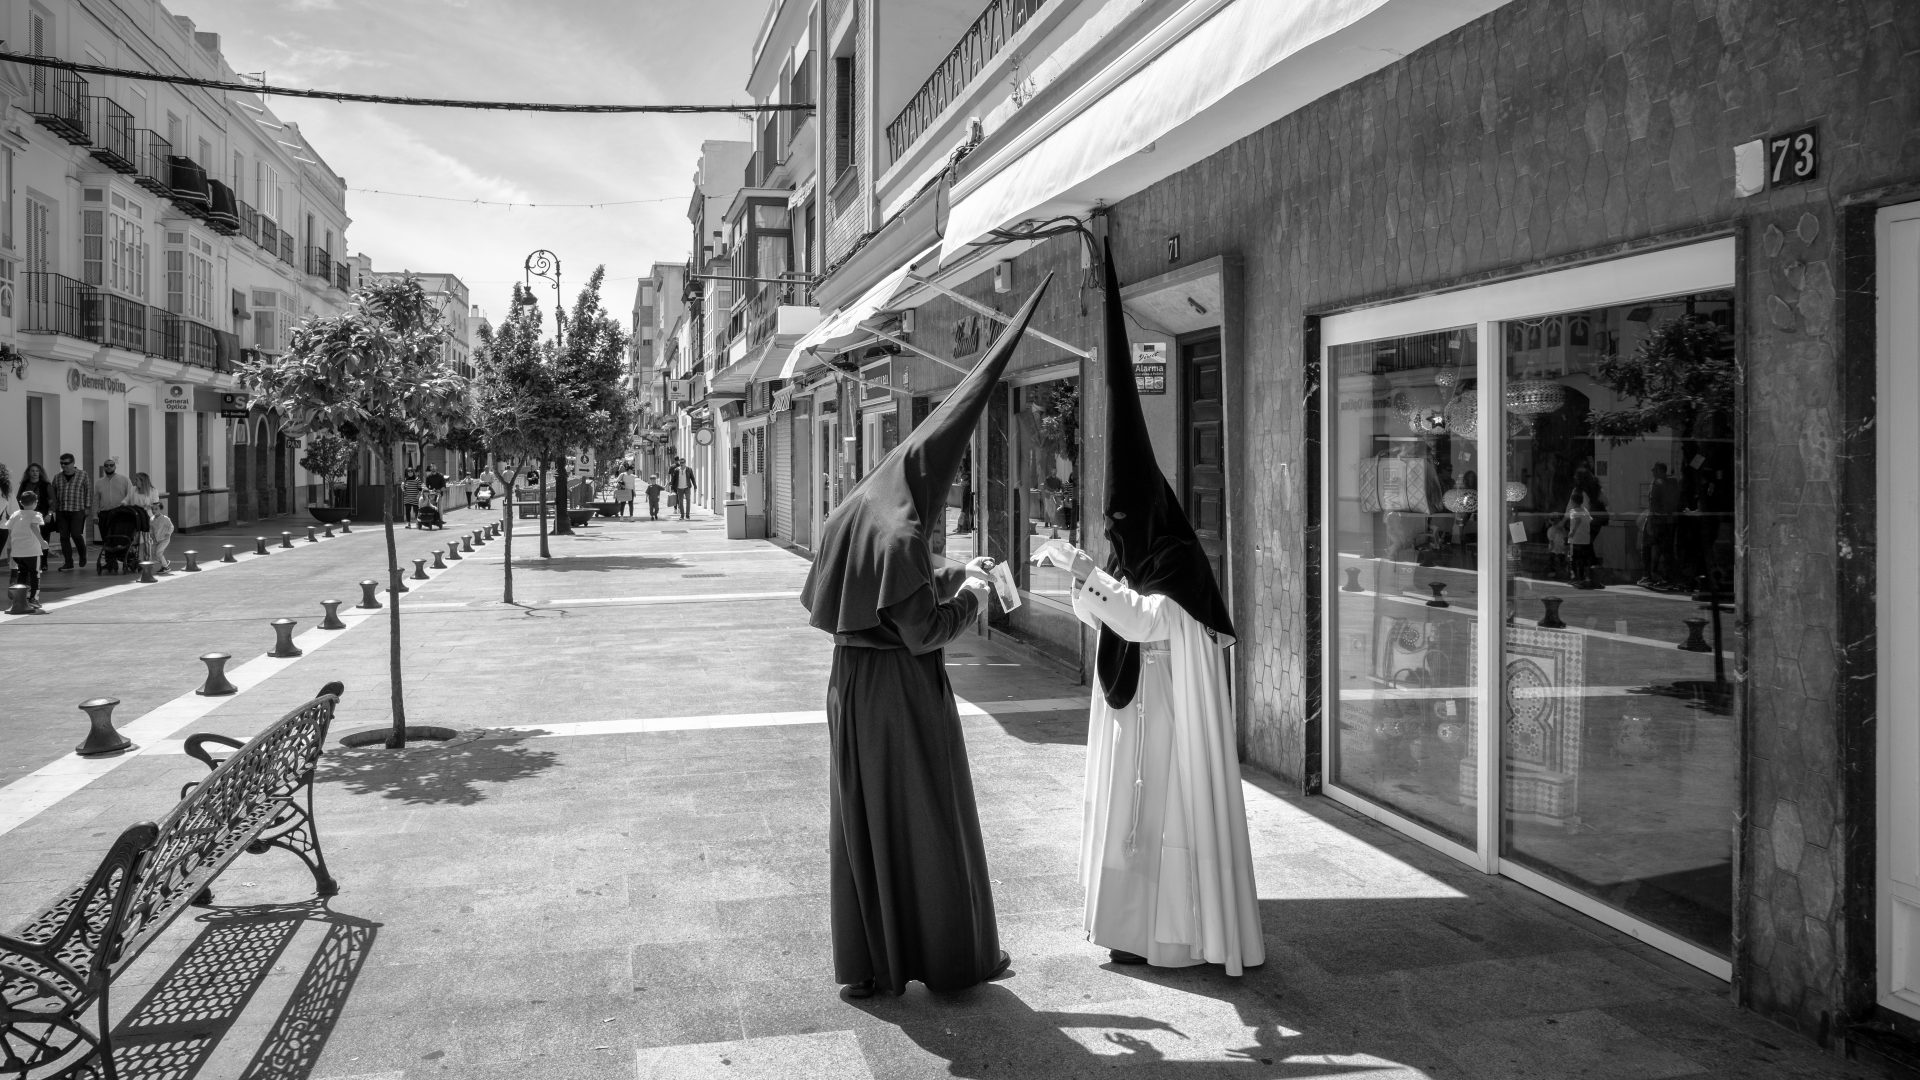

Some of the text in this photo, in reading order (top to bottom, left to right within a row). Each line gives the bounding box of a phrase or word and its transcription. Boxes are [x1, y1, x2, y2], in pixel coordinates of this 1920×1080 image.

[1772, 133, 1814, 183] 73
[1168, 237, 1178, 261] 71
[1135, 364, 1164, 372] Alarma
[81, 373, 126, 395] General Optica
[234, 395, 246, 410] S
[287, 440, 300, 448] PAN
